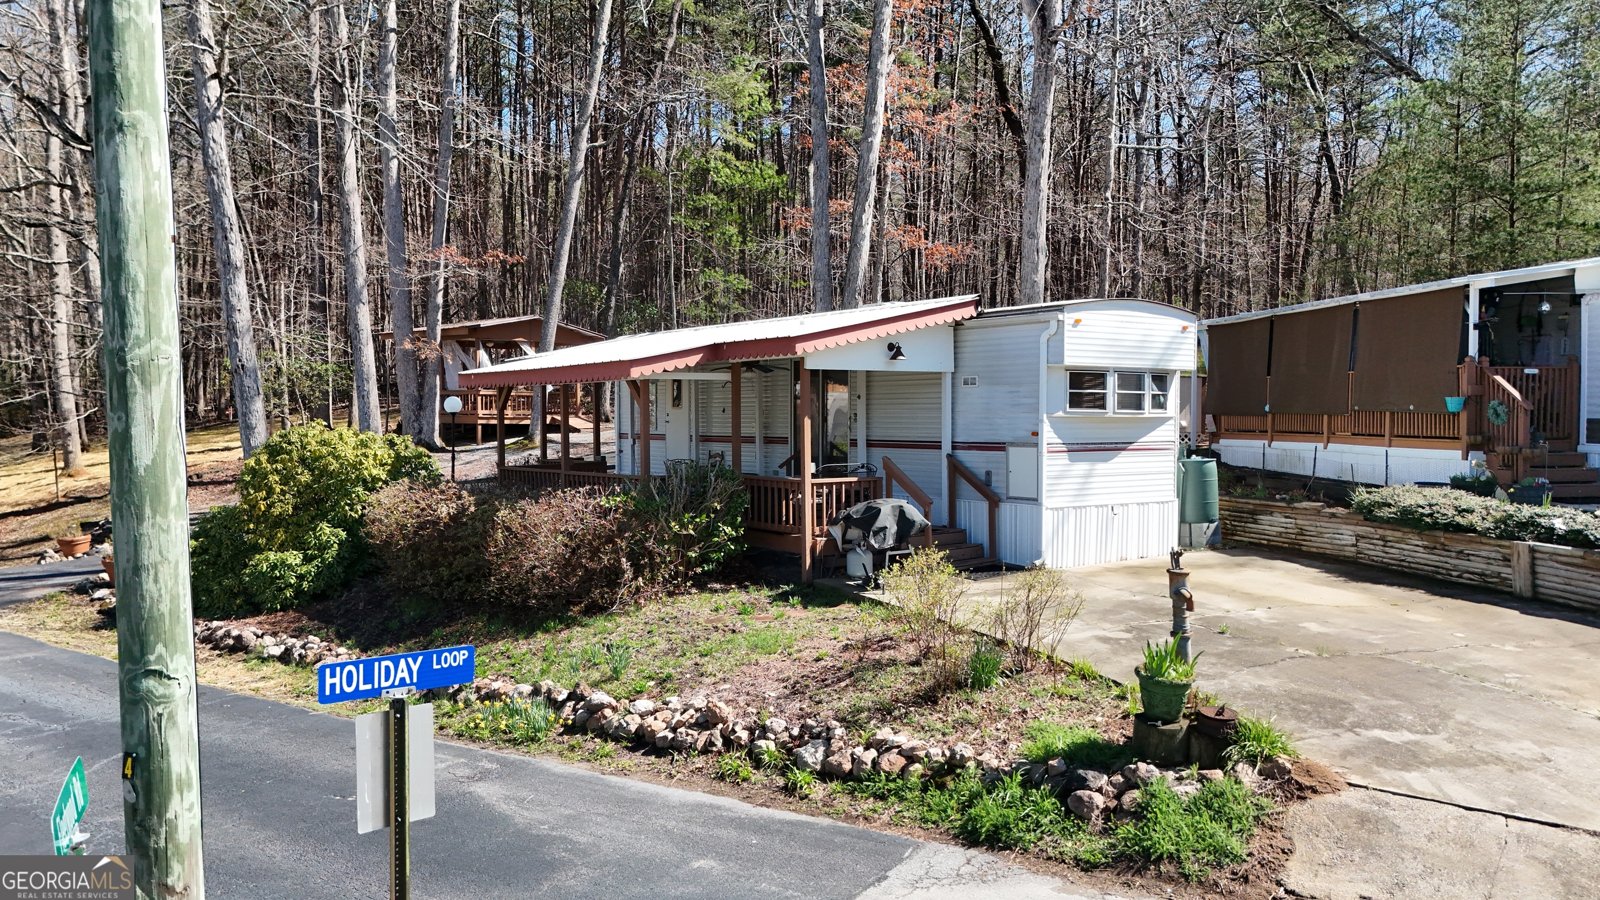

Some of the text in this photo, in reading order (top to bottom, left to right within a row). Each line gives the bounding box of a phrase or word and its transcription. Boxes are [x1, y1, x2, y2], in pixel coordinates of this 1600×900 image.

[325, 650, 468, 695] HOLIDAY LOOP
[125, 757, 132, 778] 4
